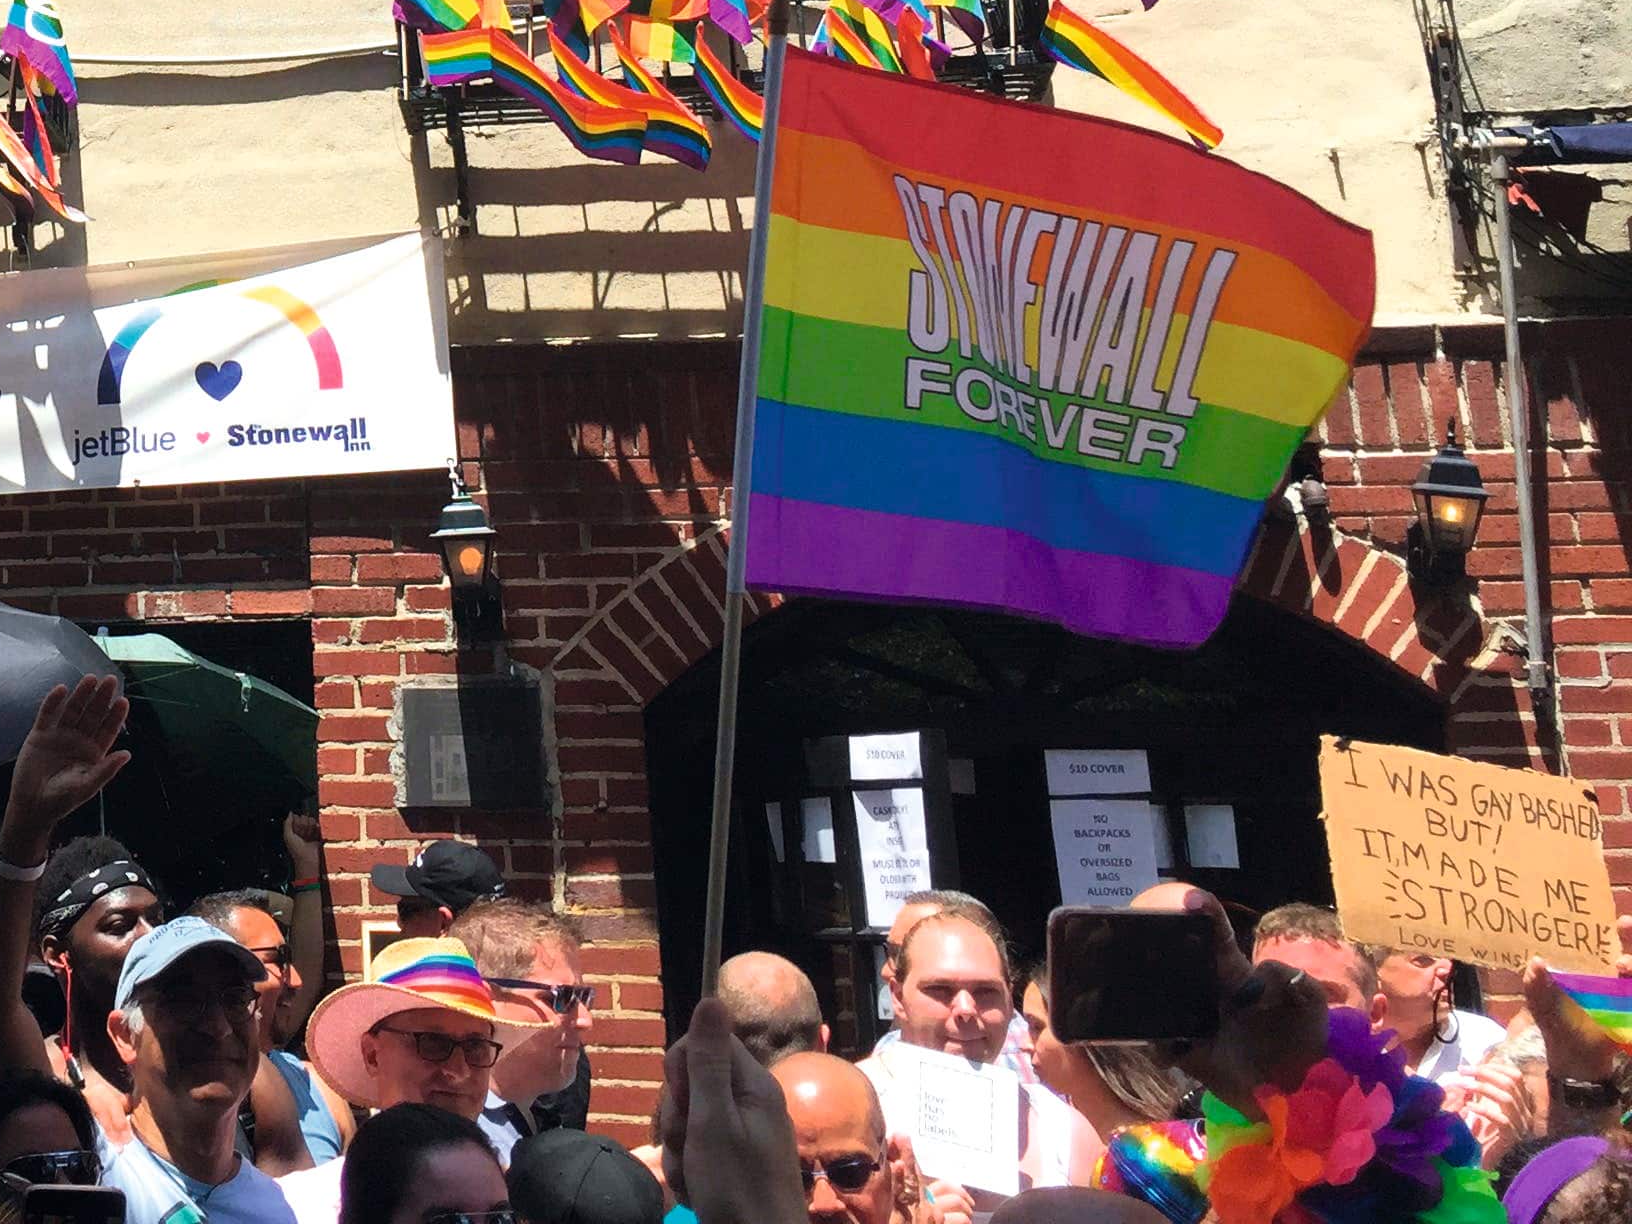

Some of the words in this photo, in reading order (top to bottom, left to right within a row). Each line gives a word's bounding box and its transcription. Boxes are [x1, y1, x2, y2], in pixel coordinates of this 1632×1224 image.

[893, 174, 1239, 418] STONEWALL
[904, 356, 1188, 469] FOREVER
[72, 427, 176, 466] jetBlue
[227, 417, 367, 447] Stonewall
[343, 437, 371, 452] Inn
[1069, 763, 1088, 774] $10
[1090, 764, 1125, 774] COVER
[1344, 748, 1369, 788] I
[1379, 759, 1458, 806] WAS
[1471, 783, 1513, 823] GAY
[1518, 792, 1601, 841] BASHED
[1093, 814, 1108, 824] NO
[1425, 807, 1503, 855] BUT!
[1074, 829, 1131, 838] BACKPACKS
[1097, 843, 1111, 852] OR
[1080, 857, 1133, 867] OVERSIZED
[1096, 872, 1120, 882] BAGS
[1087, 887, 1133, 896] ALLOWED
[1544, 879, 1591, 916] ME
[1402, 878, 1602, 956] STRONGER!
[1399, 927, 1456, 953] LOVE
[1471, 947, 1529, 969] WINS!
